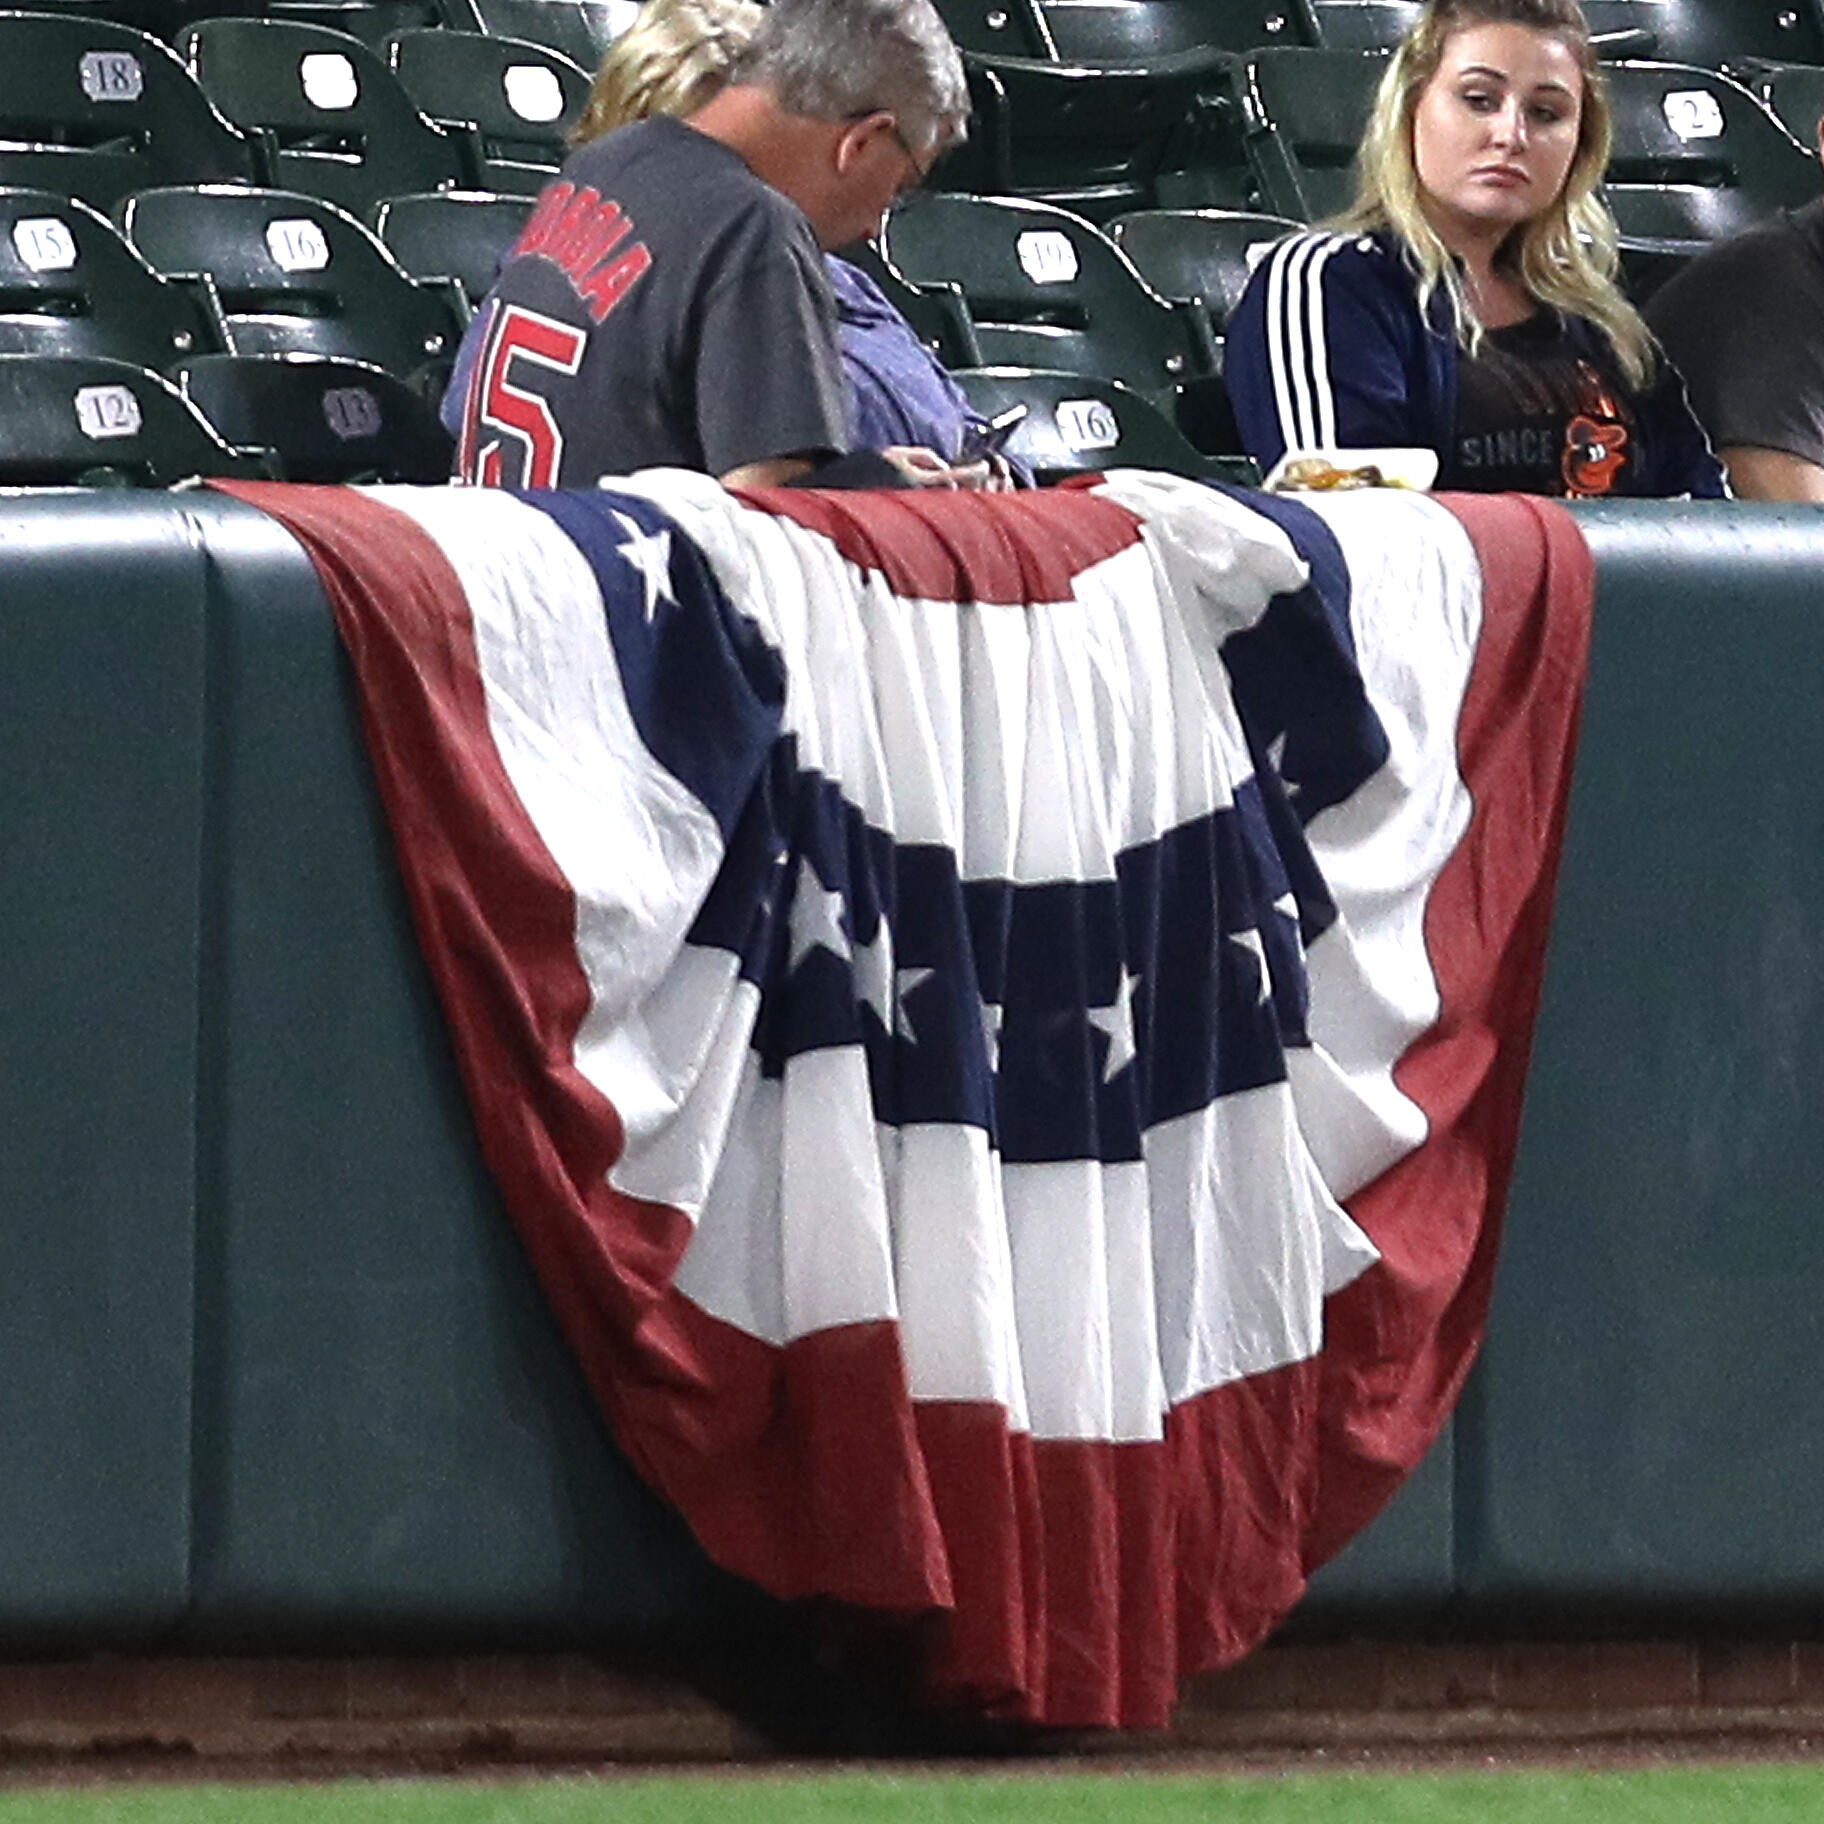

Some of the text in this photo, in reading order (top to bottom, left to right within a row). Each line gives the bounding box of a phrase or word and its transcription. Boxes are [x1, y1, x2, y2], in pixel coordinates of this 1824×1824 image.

[97, 59, 129, 92] 18
[1682, 99, 1704, 129] 2
[31, 227, 64, 258] 15
[283, 229, 317, 260] 16
[93, 394, 129, 428] 12
[337, 394, 368, 428] 13
[1072, 406, 1108, 441] 16
[1462, 428, 1551, 466] SINCE
